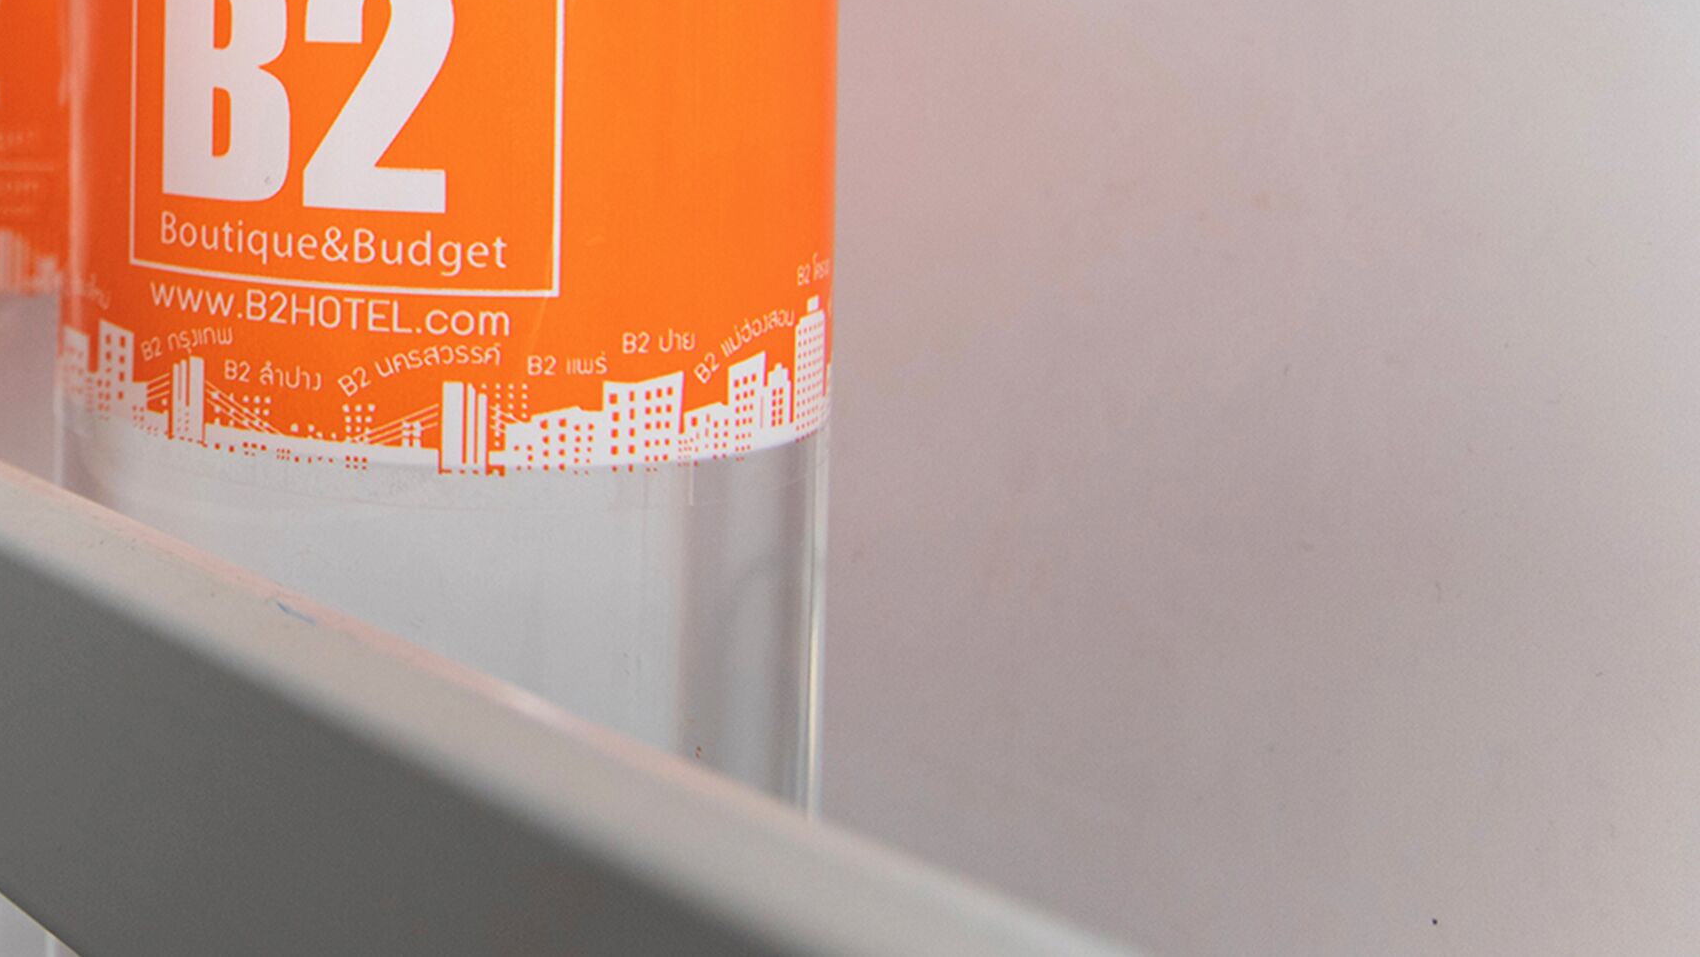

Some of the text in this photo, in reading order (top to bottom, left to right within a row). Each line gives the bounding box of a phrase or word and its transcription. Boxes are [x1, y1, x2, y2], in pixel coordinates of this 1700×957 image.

[160, 210, 508, 277] Boutique&Budget
[149, 280, 512, 336] www.B2HOTEL.com
[140, 336, 162, 362] B2
[622, 328, 696, 354] B2 ปาย
[224, 359, 322, 391] B2 ลำปาง
[527, 351, 608, 375] B2 แพร่
[693, 352, 721, 384] B2
[337, 366, 371, 397] B2
